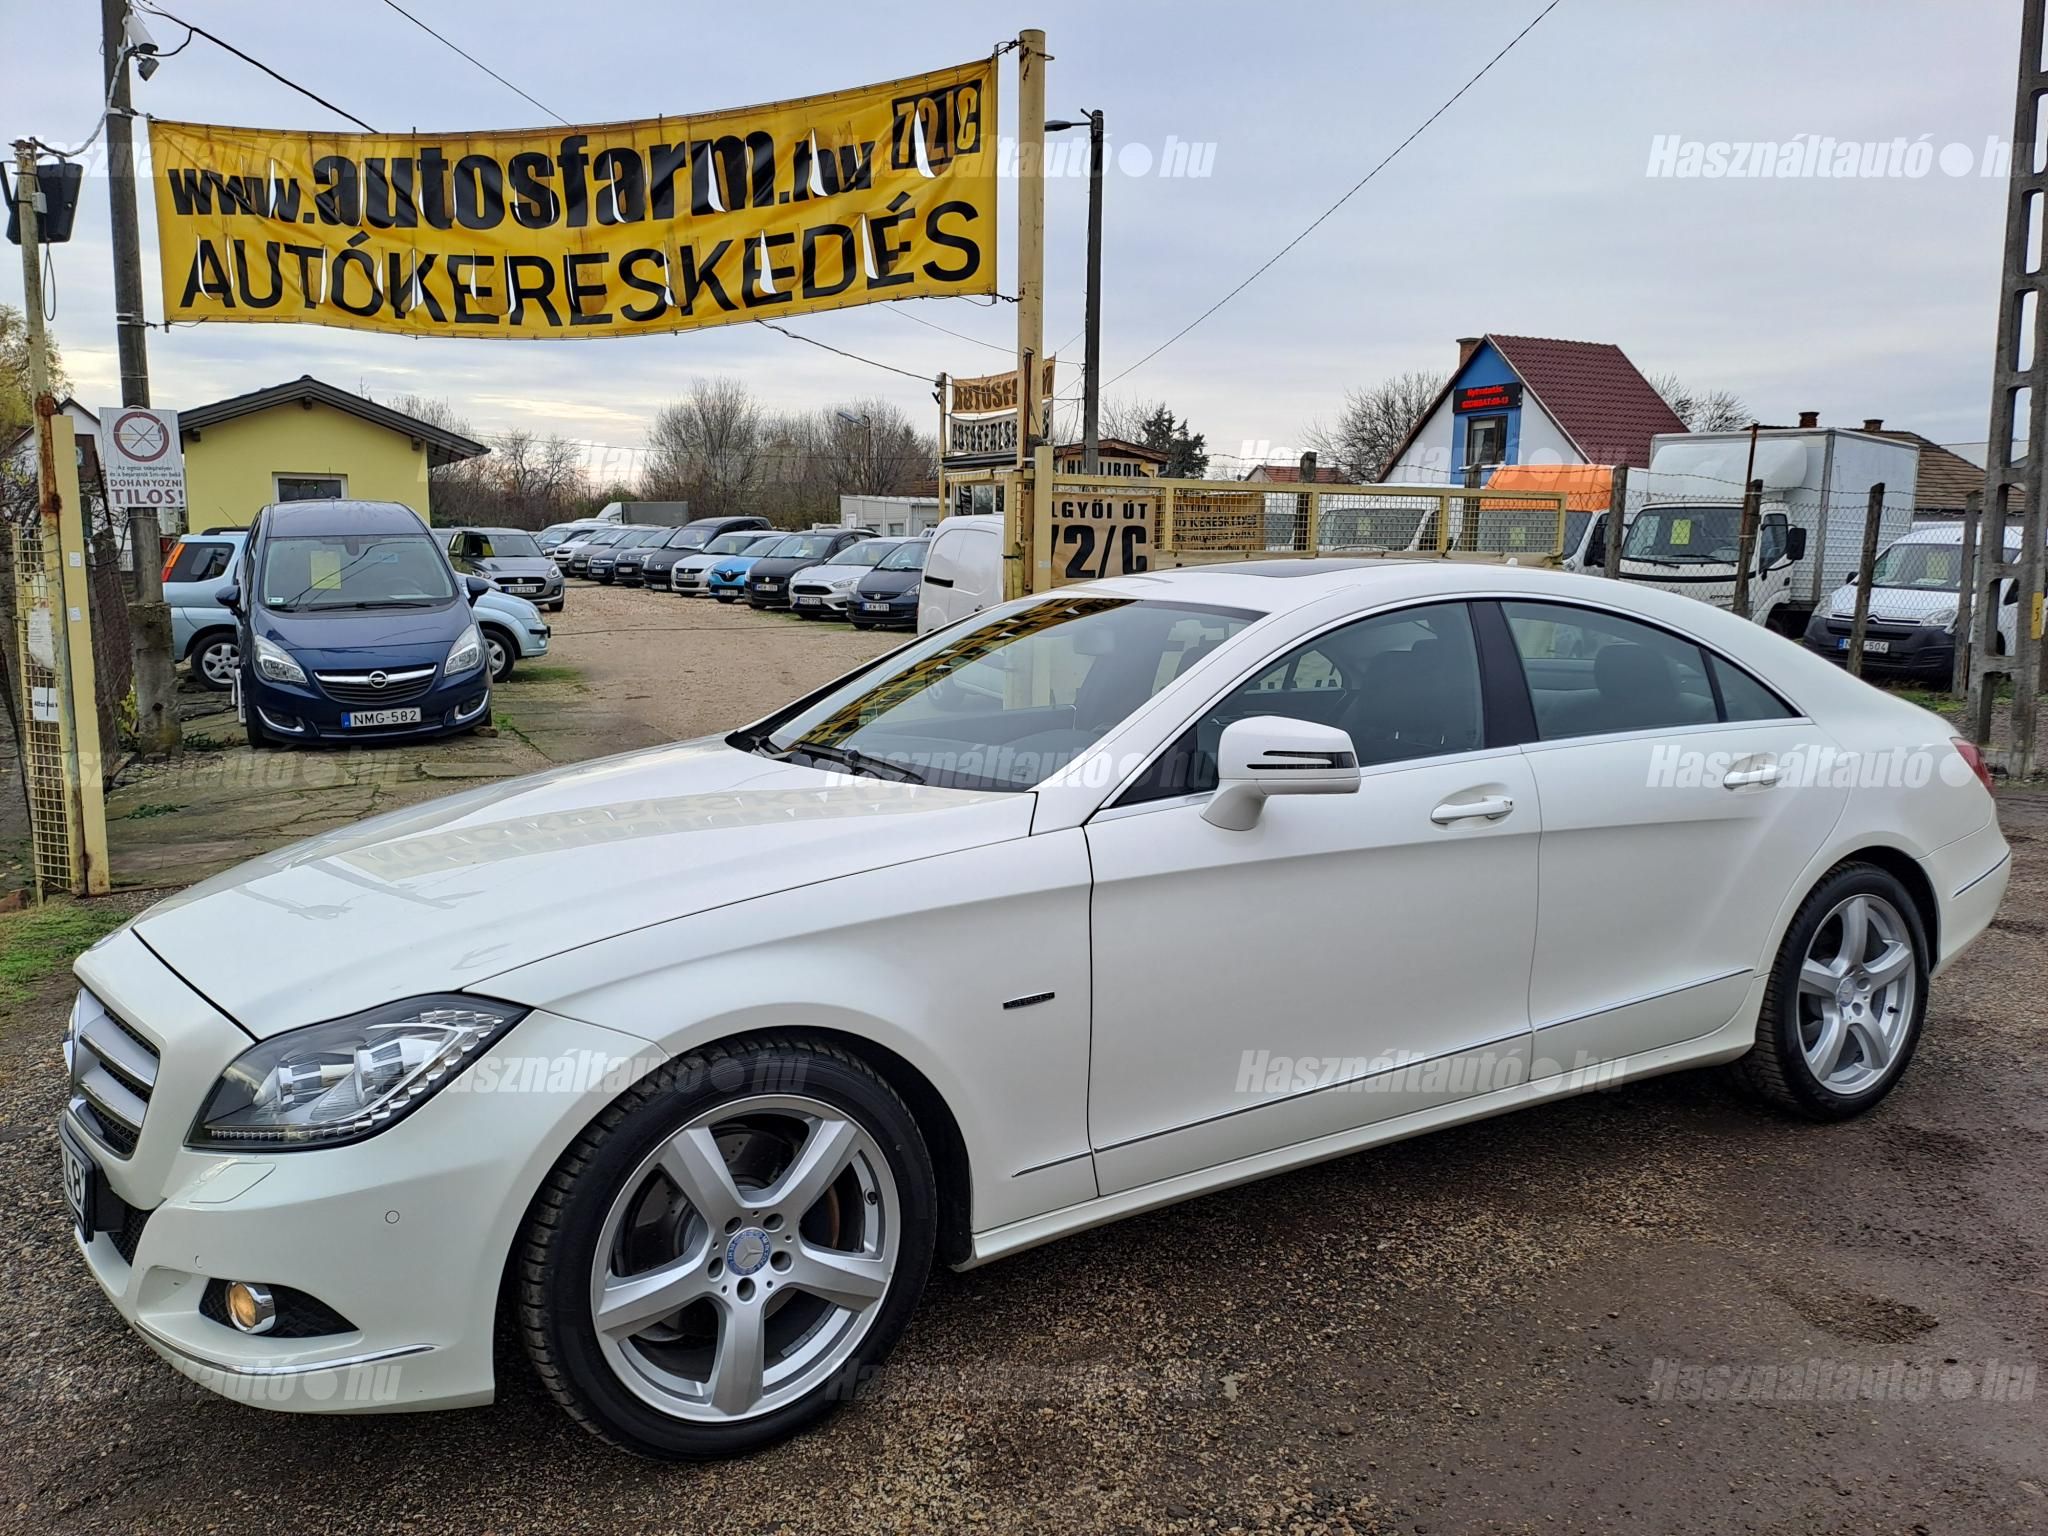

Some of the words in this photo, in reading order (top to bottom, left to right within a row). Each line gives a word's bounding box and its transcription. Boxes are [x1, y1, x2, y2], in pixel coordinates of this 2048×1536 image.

[168, 131, 876, 230] www.autosfarm.hu
[180, 192, 981, 326] AUTÓKERESKEDÉS
[111, 489, 184, 505] TILOS!
[1051, 524, 1148, 579] 2/C
[353, 710, 418, 725] NMG-582
